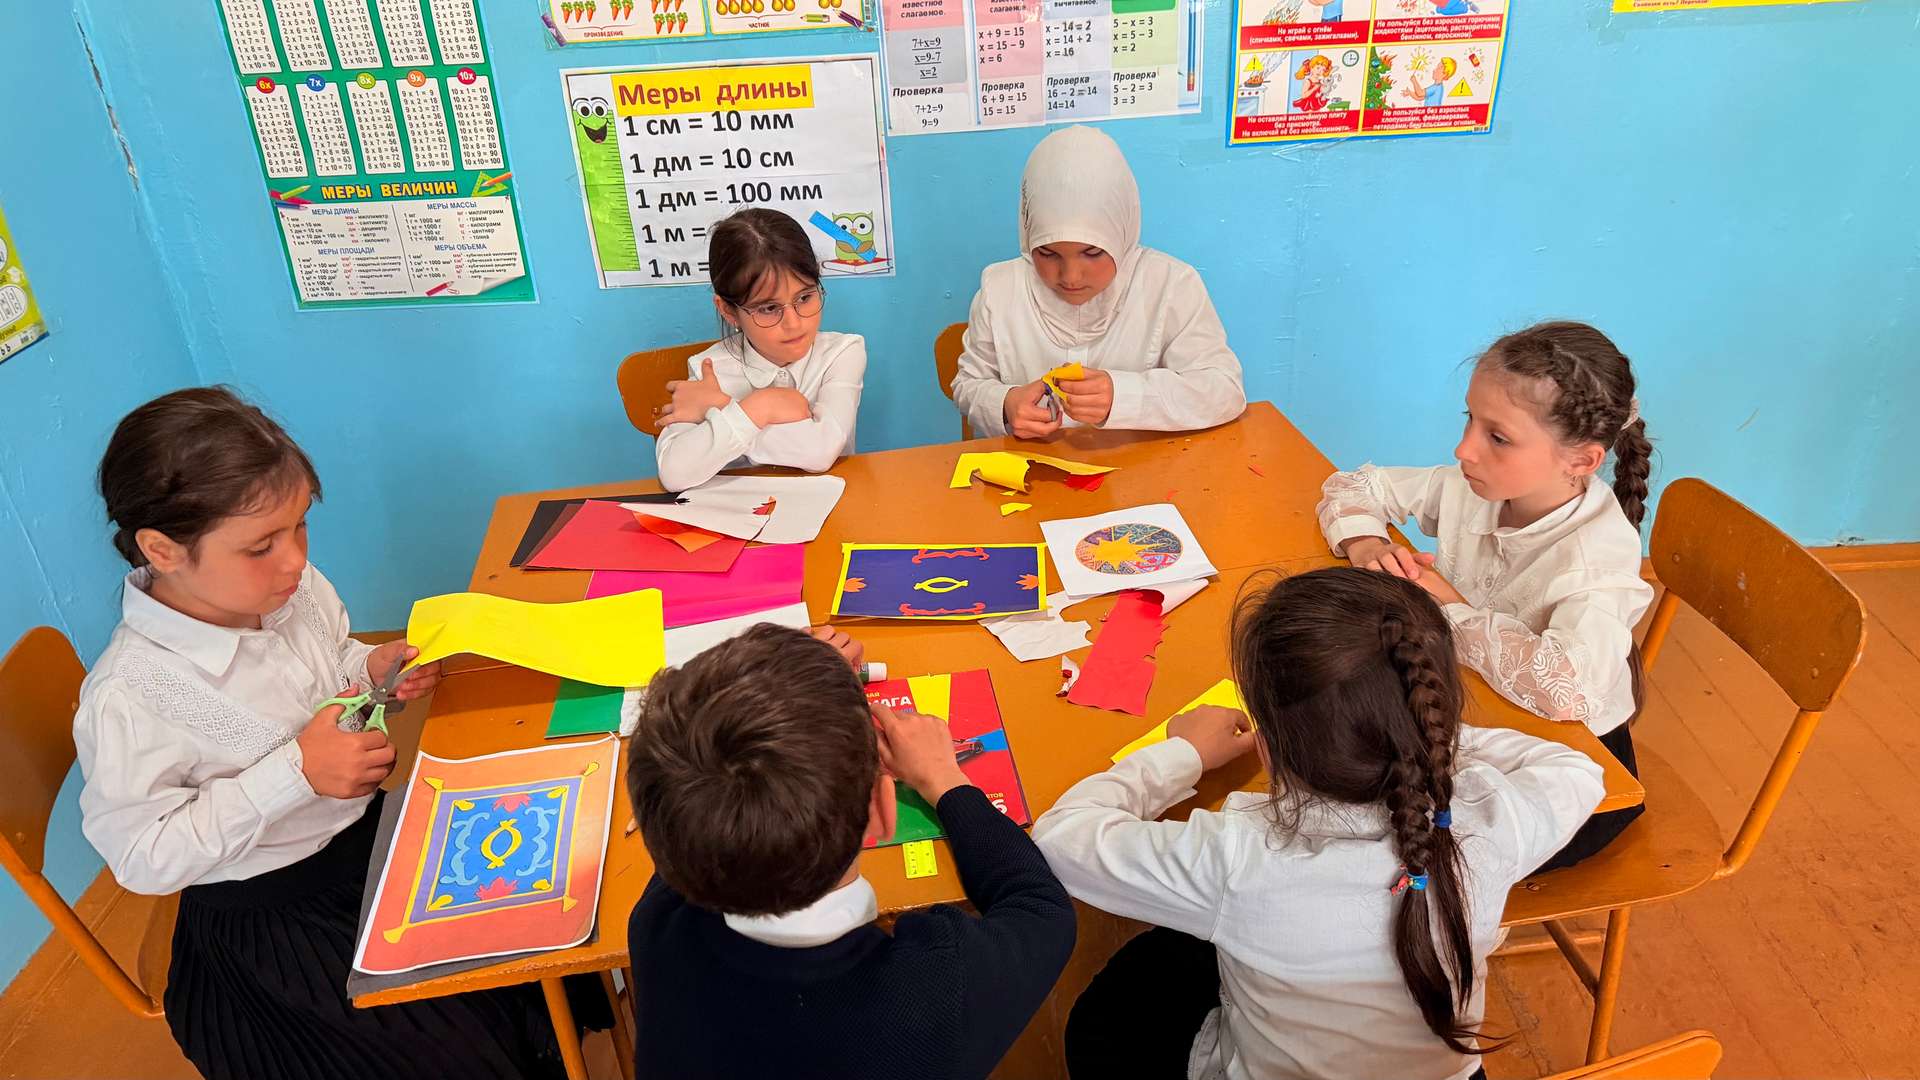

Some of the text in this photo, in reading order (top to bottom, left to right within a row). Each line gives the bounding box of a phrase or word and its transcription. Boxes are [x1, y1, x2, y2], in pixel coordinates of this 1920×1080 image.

[1063, 22, 1074, 32] 14
[1086, 21, 1092, 30] 2
[1114, 19, 1119, 28] 5
[1148, 17, 1153, 26] 3
[996, 28, 1001, 37] 9
[1014, 27, 1025, 36] 15
[1130, 30, 1136, 39] 5
[1148, 29, 1153, 38] 3
[912, 37, 941, 48] 7+x=9
[1063, 35, 1073, 44] 14
[1086, 34, 1092, 42] 2
[997, 41, 1007, 50] 15
[1019, 40, 1025, 48] 9
[1130, 43, 1136, 52] 2
[915, 52, 941, 63] x=9-7
[997, 54, 1002, 62] 6
[920, 67, 937, 77] x=2
[1113, 72, 1156, 83] Проверка
[411, 74, 422, 82] 9x
[1047, 76, 1090, 87] Проверка
[259, 81, 271, 89] 6x
[982, 81, 1025, 93] Проверка
[1113, 84, 1119, 93] 5
[1131, 84, 1136, 92] 2
[1148, 83, 1153, 91] 3
[619, 81, 807, 108] Меры длины
[893, 86, 944, 97] Проверка
[1048, 89, 1058, 98] 16
[1070, 88, 1075, 97] 2
[1087, 86, 1097, 95] 14
[982, 94, 987, 103] 6
[999, 93, 1005, 102] 9
[1017, 92, 1027, 101] 15
[1113, 97, 1118, 105] 3
[1130, 96, 1135, 104] 3
[915, 104, 943, 114] 7+2=9
[984, 107, 993, 116] 15
[1006, 105, 1016, 114] 15
[624, 110, 794, 136] 1 см = 10 мм
[922, 118, 938, 127] 9=9
[630, 148, 794, 177] 1 дм = 10 см
[322, 182, 457, 199] МЕРЫ ВЕЛИЧИН
[636, 182, 823, 212] 1 дм = 100 мм
[642, 224, 705, 243] 1 м =
[649, 259, 663, 278] 1
[671, 262, 691, 276] м
